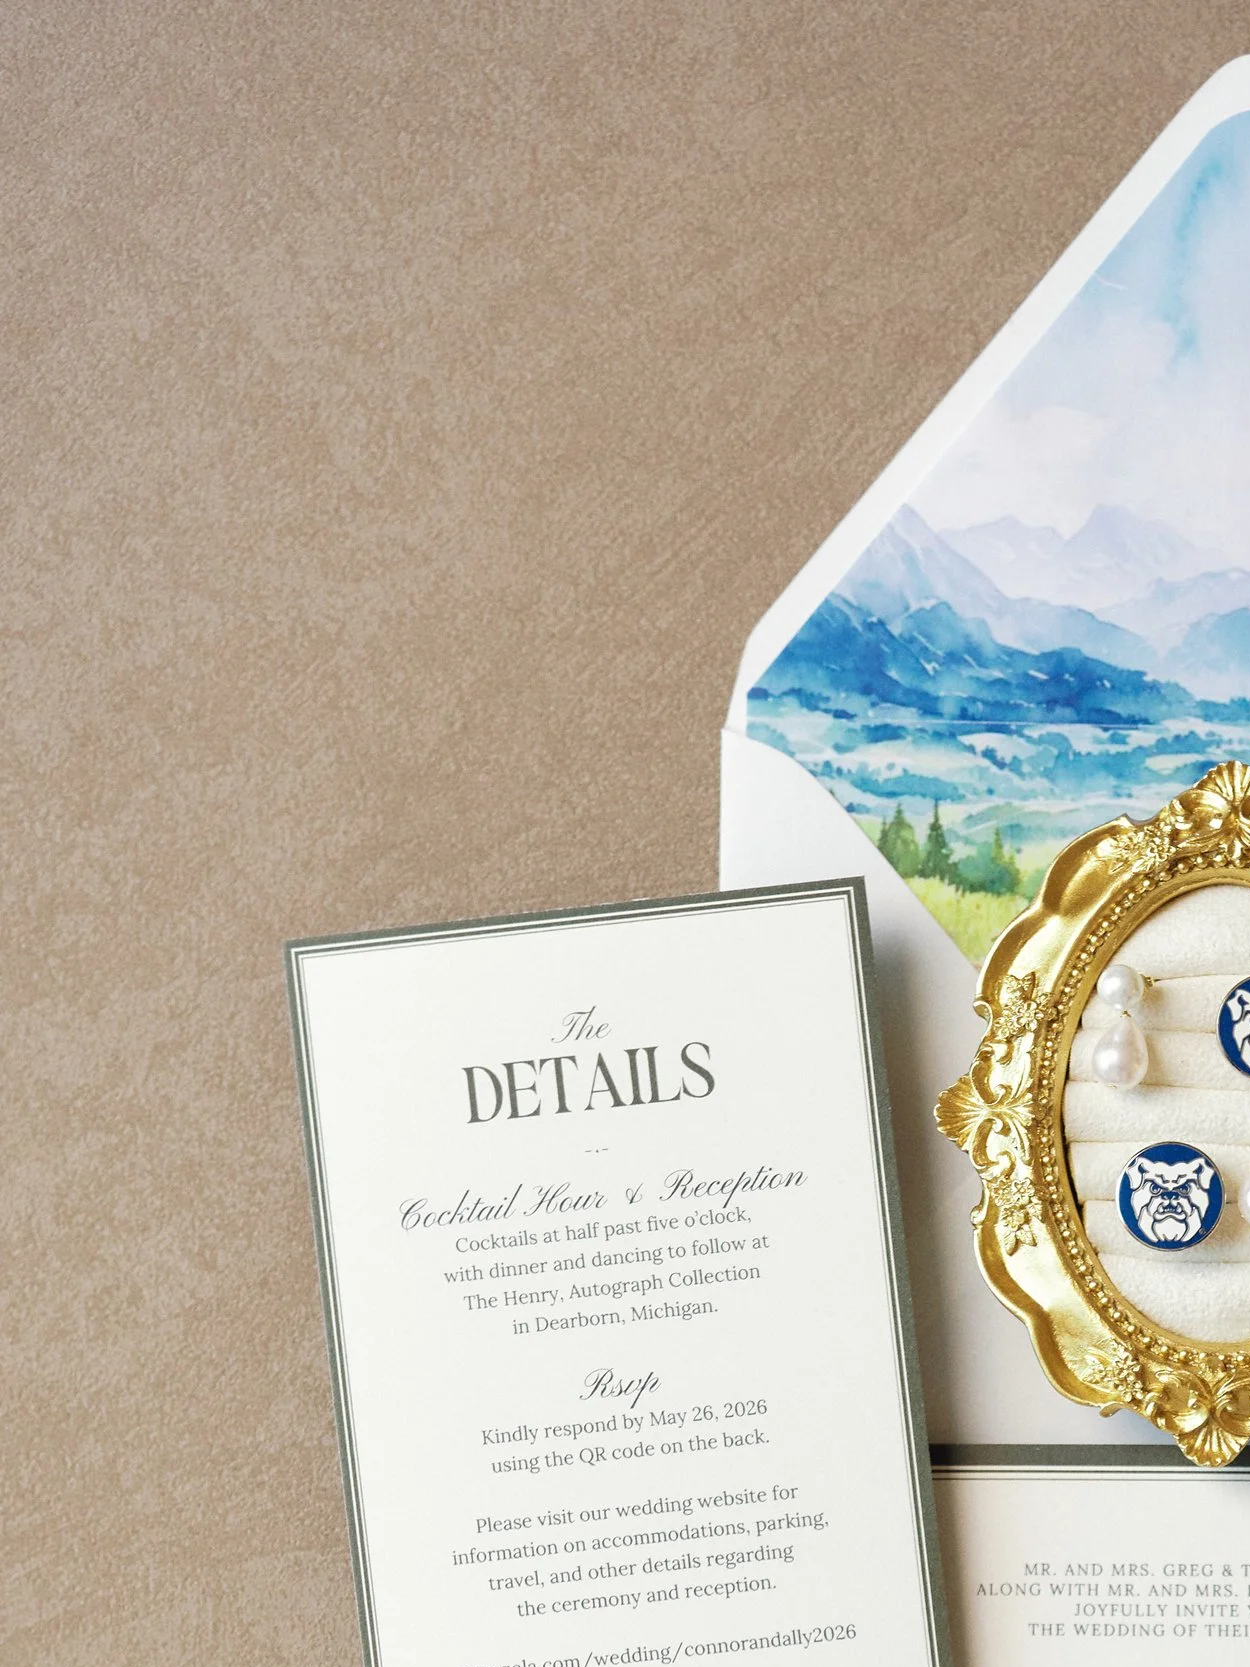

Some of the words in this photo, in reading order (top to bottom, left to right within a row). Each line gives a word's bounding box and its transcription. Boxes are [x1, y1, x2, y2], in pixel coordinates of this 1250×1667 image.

[550, 1005, 611, 1044] The
[461, 1041, 716, 1125] DETAILS
[398, 1183, 518, 1232] Cocktail
[522, 1181, 608, 1217] Hour
[625, 1182, 644, 1205] &
[658, 1165, 809, 1210] Reception
[455, 1229, 538, 1254] Cocktails
[543, 1229, 562, 1244] at
[564, 1221, 600, 1241] half
[603, 1220, 643, 1242] past
[646, 1215, 680, 1232] five
[684, 1206, 752, 1228] o'clock,
[463, 1293, 498, 1311] The
[503, 1289, 564, 1307] Henry,
[568, 1273, 664, 1300] Autograph
[668, 1265, 761, 1288] Collection
[512, 1319, 530, 1335] in
[535, 1311, 626, 1333] Dearborn,
[630, 1300, 719, 1322] Michigan.
[578, 1367, 662, 1410] Rsvp
[481, 1424, 539, 1446] Kindly
[543, 1414, 619, 1441] respond
[621, 1413, 644, 1434] by
[649, 1410, 688, 1429] May
[691, 1404, 719, 1423] 26,
[723, 1398, 768, 1419] 2026
[476, 1516, 532, 1534] Please
[536, 1508, 575, 1527] visit
[579, 1507, 611, 1523] our
[614, 1497, 694, 1518] wedding
[696, 1488, 767, 1509] website
[771, 1484, 799, 1501] for
[452, 1541, 559, 1566] information
[563, 1540, 587, 1554] on
[591, 1521, 751, 1551] accommodations,
[755, 1512, 829, 1537] parking,
[488, 1569, 545, 1591] travel,
[549, 1565, 583, 1585] and
[587, 1561, 637, 1580] other
[642, 1552, 702, 1575] details
[705, 1544, 795, 1570] regarding
[1024, 1562, 1056, 1577] MR.
[1064, 1563, 1104, 1577] AND
[1111, 1563, 1154, 1577] MRS.
[1162, 1563, 1214, 1577] GREG
[1221, 1563, 1233, 1578] &
[516, 1600, 547, 1617] the
[551, 1592, 642, 1614] ceremony
[646, 1583, 680, 1604] and
[684, 1576, 777, 1600] reception.
[976, 1583, 1041, 1596] ALONG
[1049, 1583, 1099, 1597] WITH
[1108, 1583, 1140, 1597] MR.
[1149, 1583, 1187, 1597] AND
[1195, 1583, 1239, 1598] MRS.
[1074, 1603, 1168, 1617] JOYFULLY
[1176, 1604, 1239, 1618] INVITE
[1028, 1623, 1065, 1637] THE
[1073, 1623, 1165, 1637] WEDDING
[1172, 1623, 1197, 1637] OF
